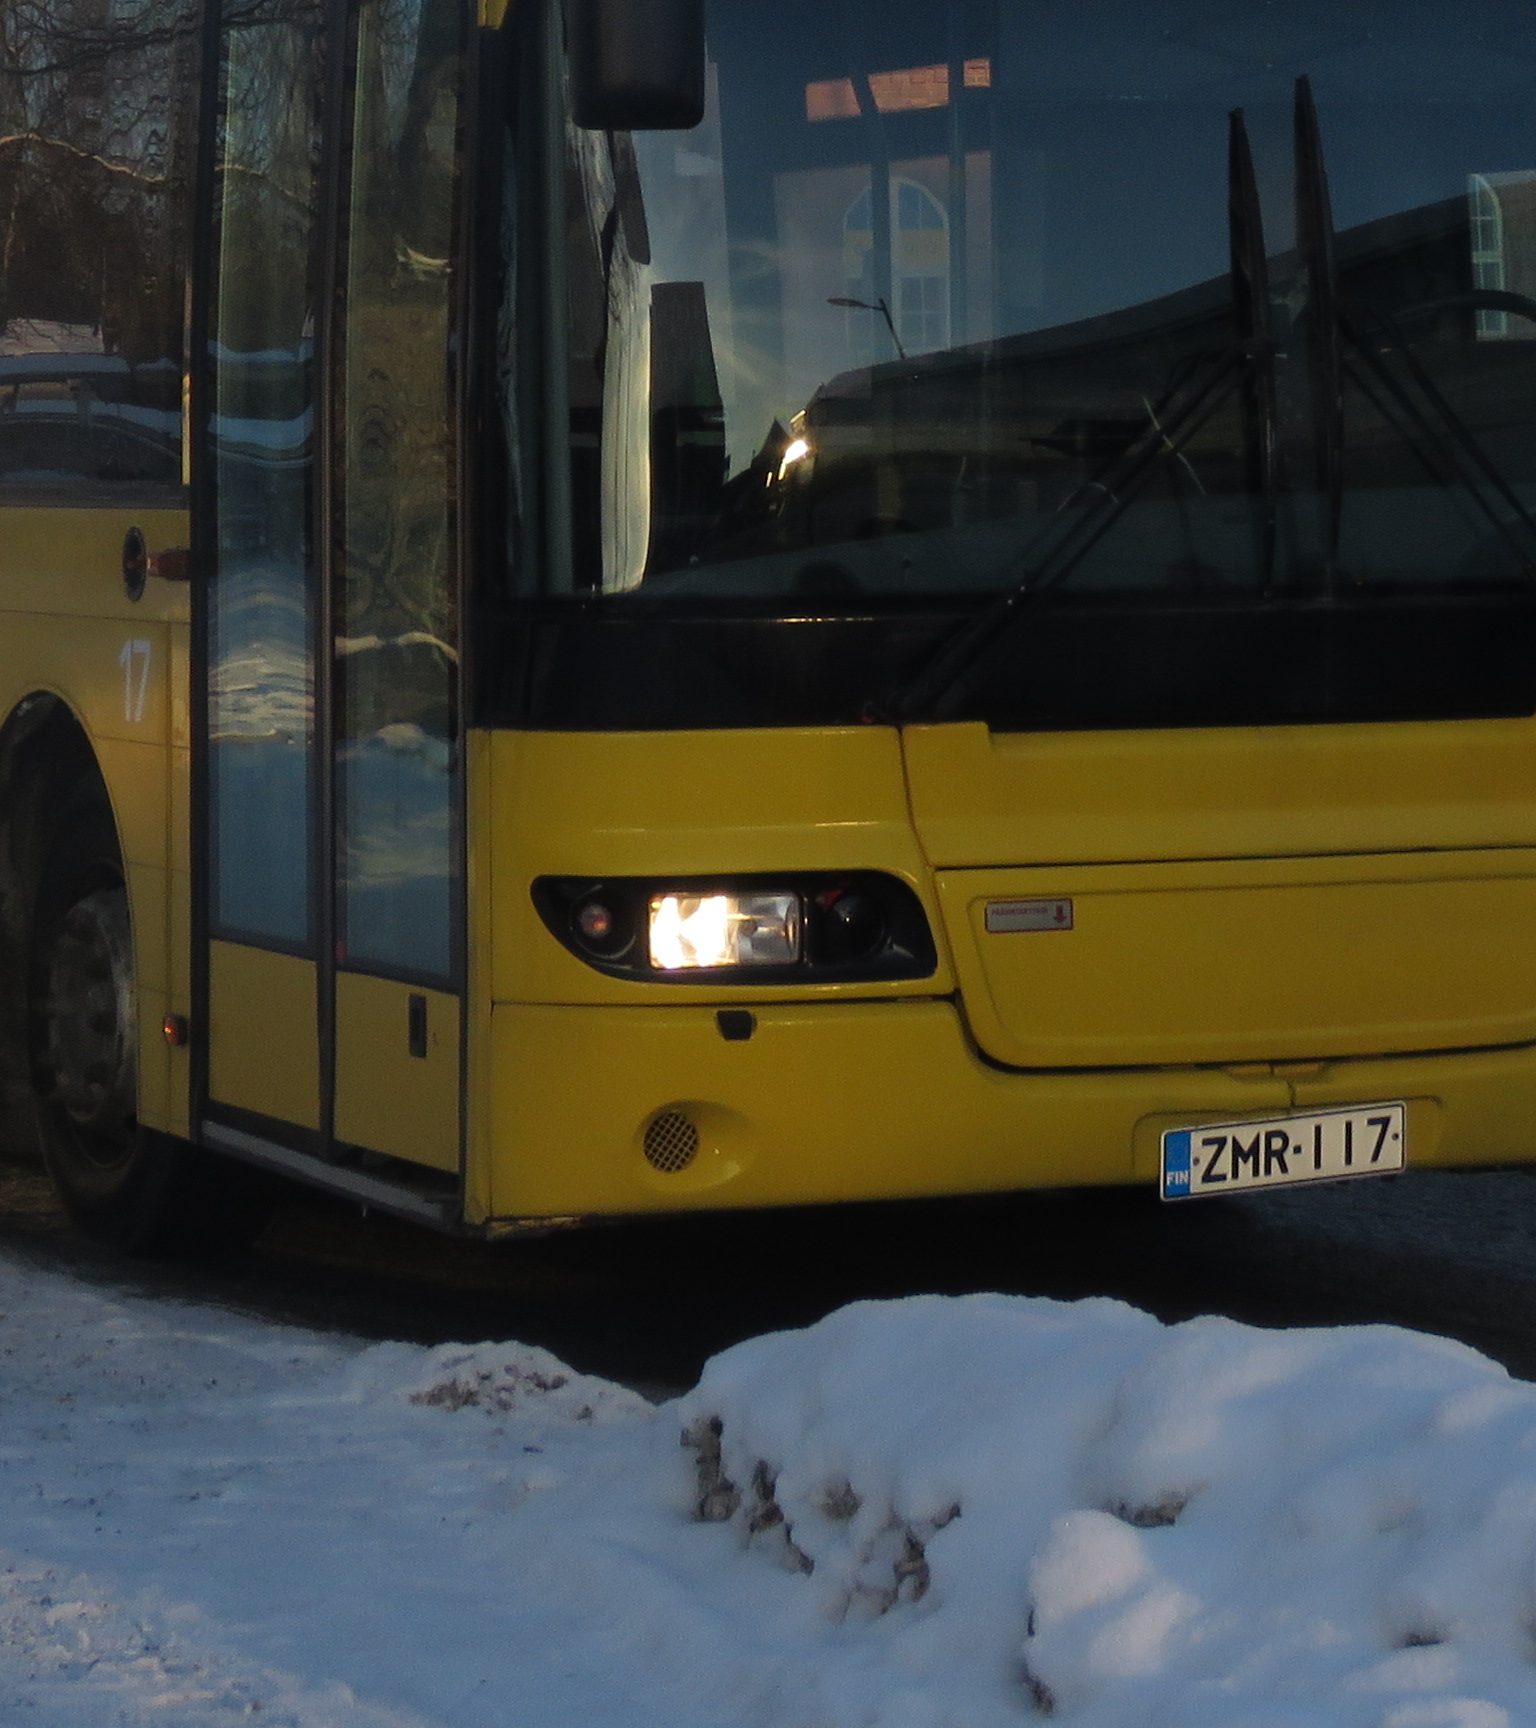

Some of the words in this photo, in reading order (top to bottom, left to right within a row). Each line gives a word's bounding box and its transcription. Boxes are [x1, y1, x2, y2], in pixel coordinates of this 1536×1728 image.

[119, 639, 152, 722] 17
[1166, 1171, 1189, 1186] FIN
[1201, 1116, 1392, 1184] ZMR-117
